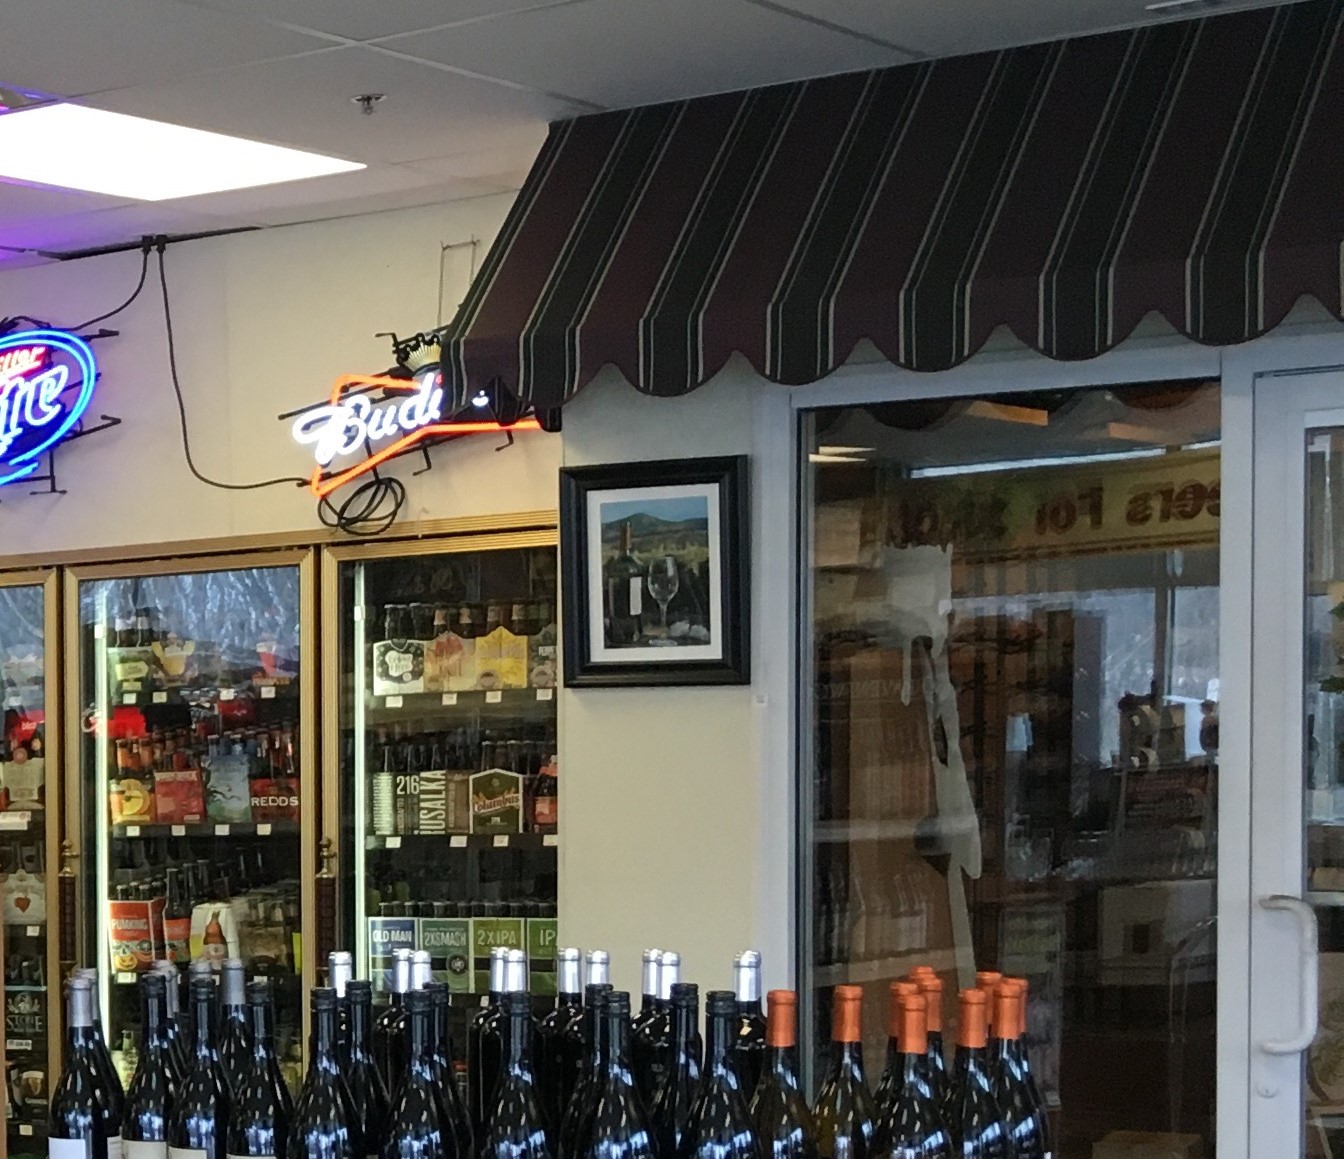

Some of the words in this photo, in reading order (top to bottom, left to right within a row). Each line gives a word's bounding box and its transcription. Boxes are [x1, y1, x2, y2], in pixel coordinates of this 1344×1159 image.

[396, 776, 419, 795] 216
[390, 929, 413, 942] MAN
[539, 929, 557, 946] IP
